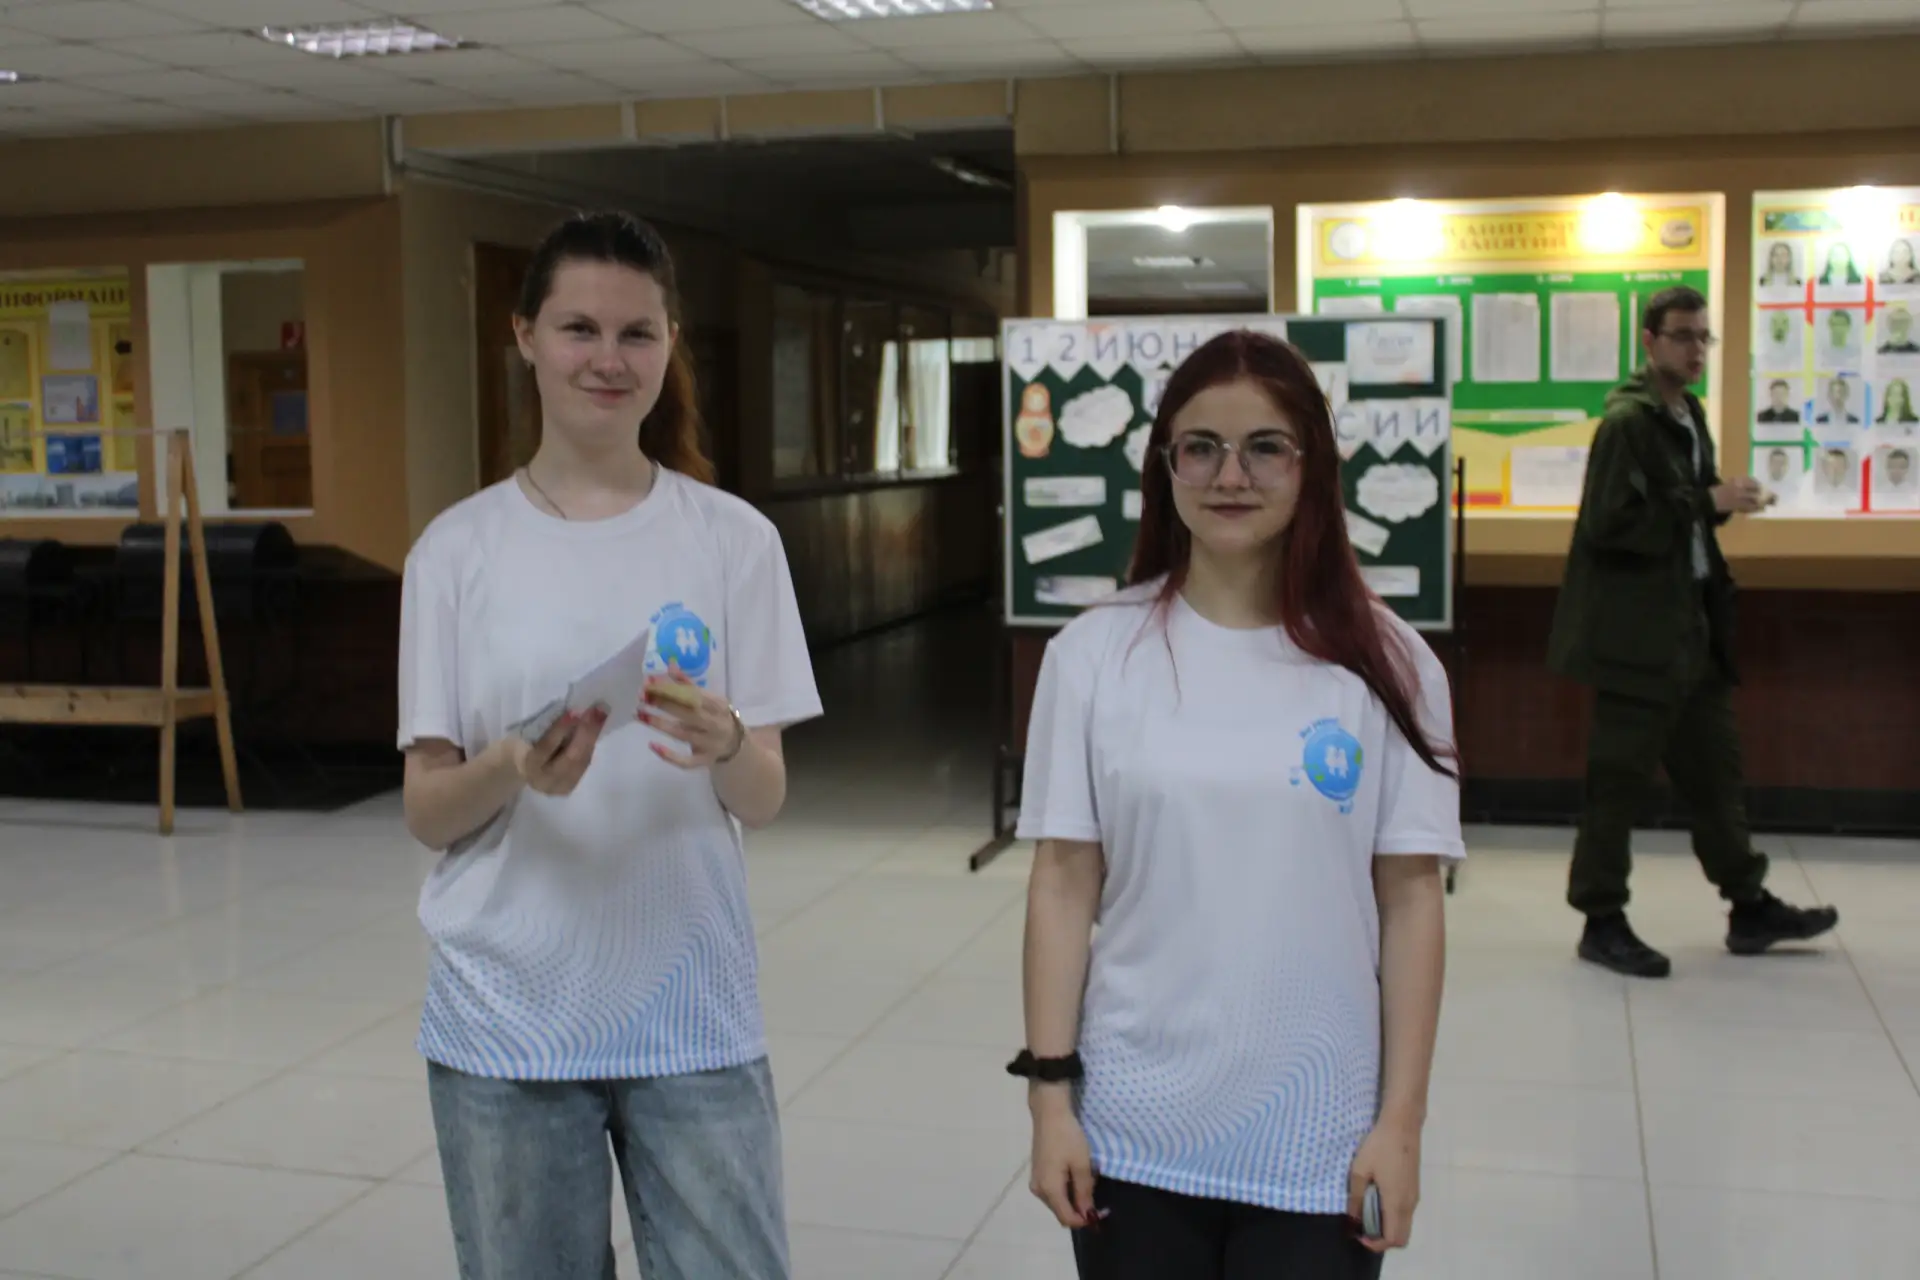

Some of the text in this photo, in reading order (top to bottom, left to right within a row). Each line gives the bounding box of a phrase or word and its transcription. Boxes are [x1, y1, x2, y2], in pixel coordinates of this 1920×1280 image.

[0, 287, 126, 308] НФОРМАЦ
[1094, 329, 1198, 361] ИЮН
[1334, 406, 1441, 441] СИИ
